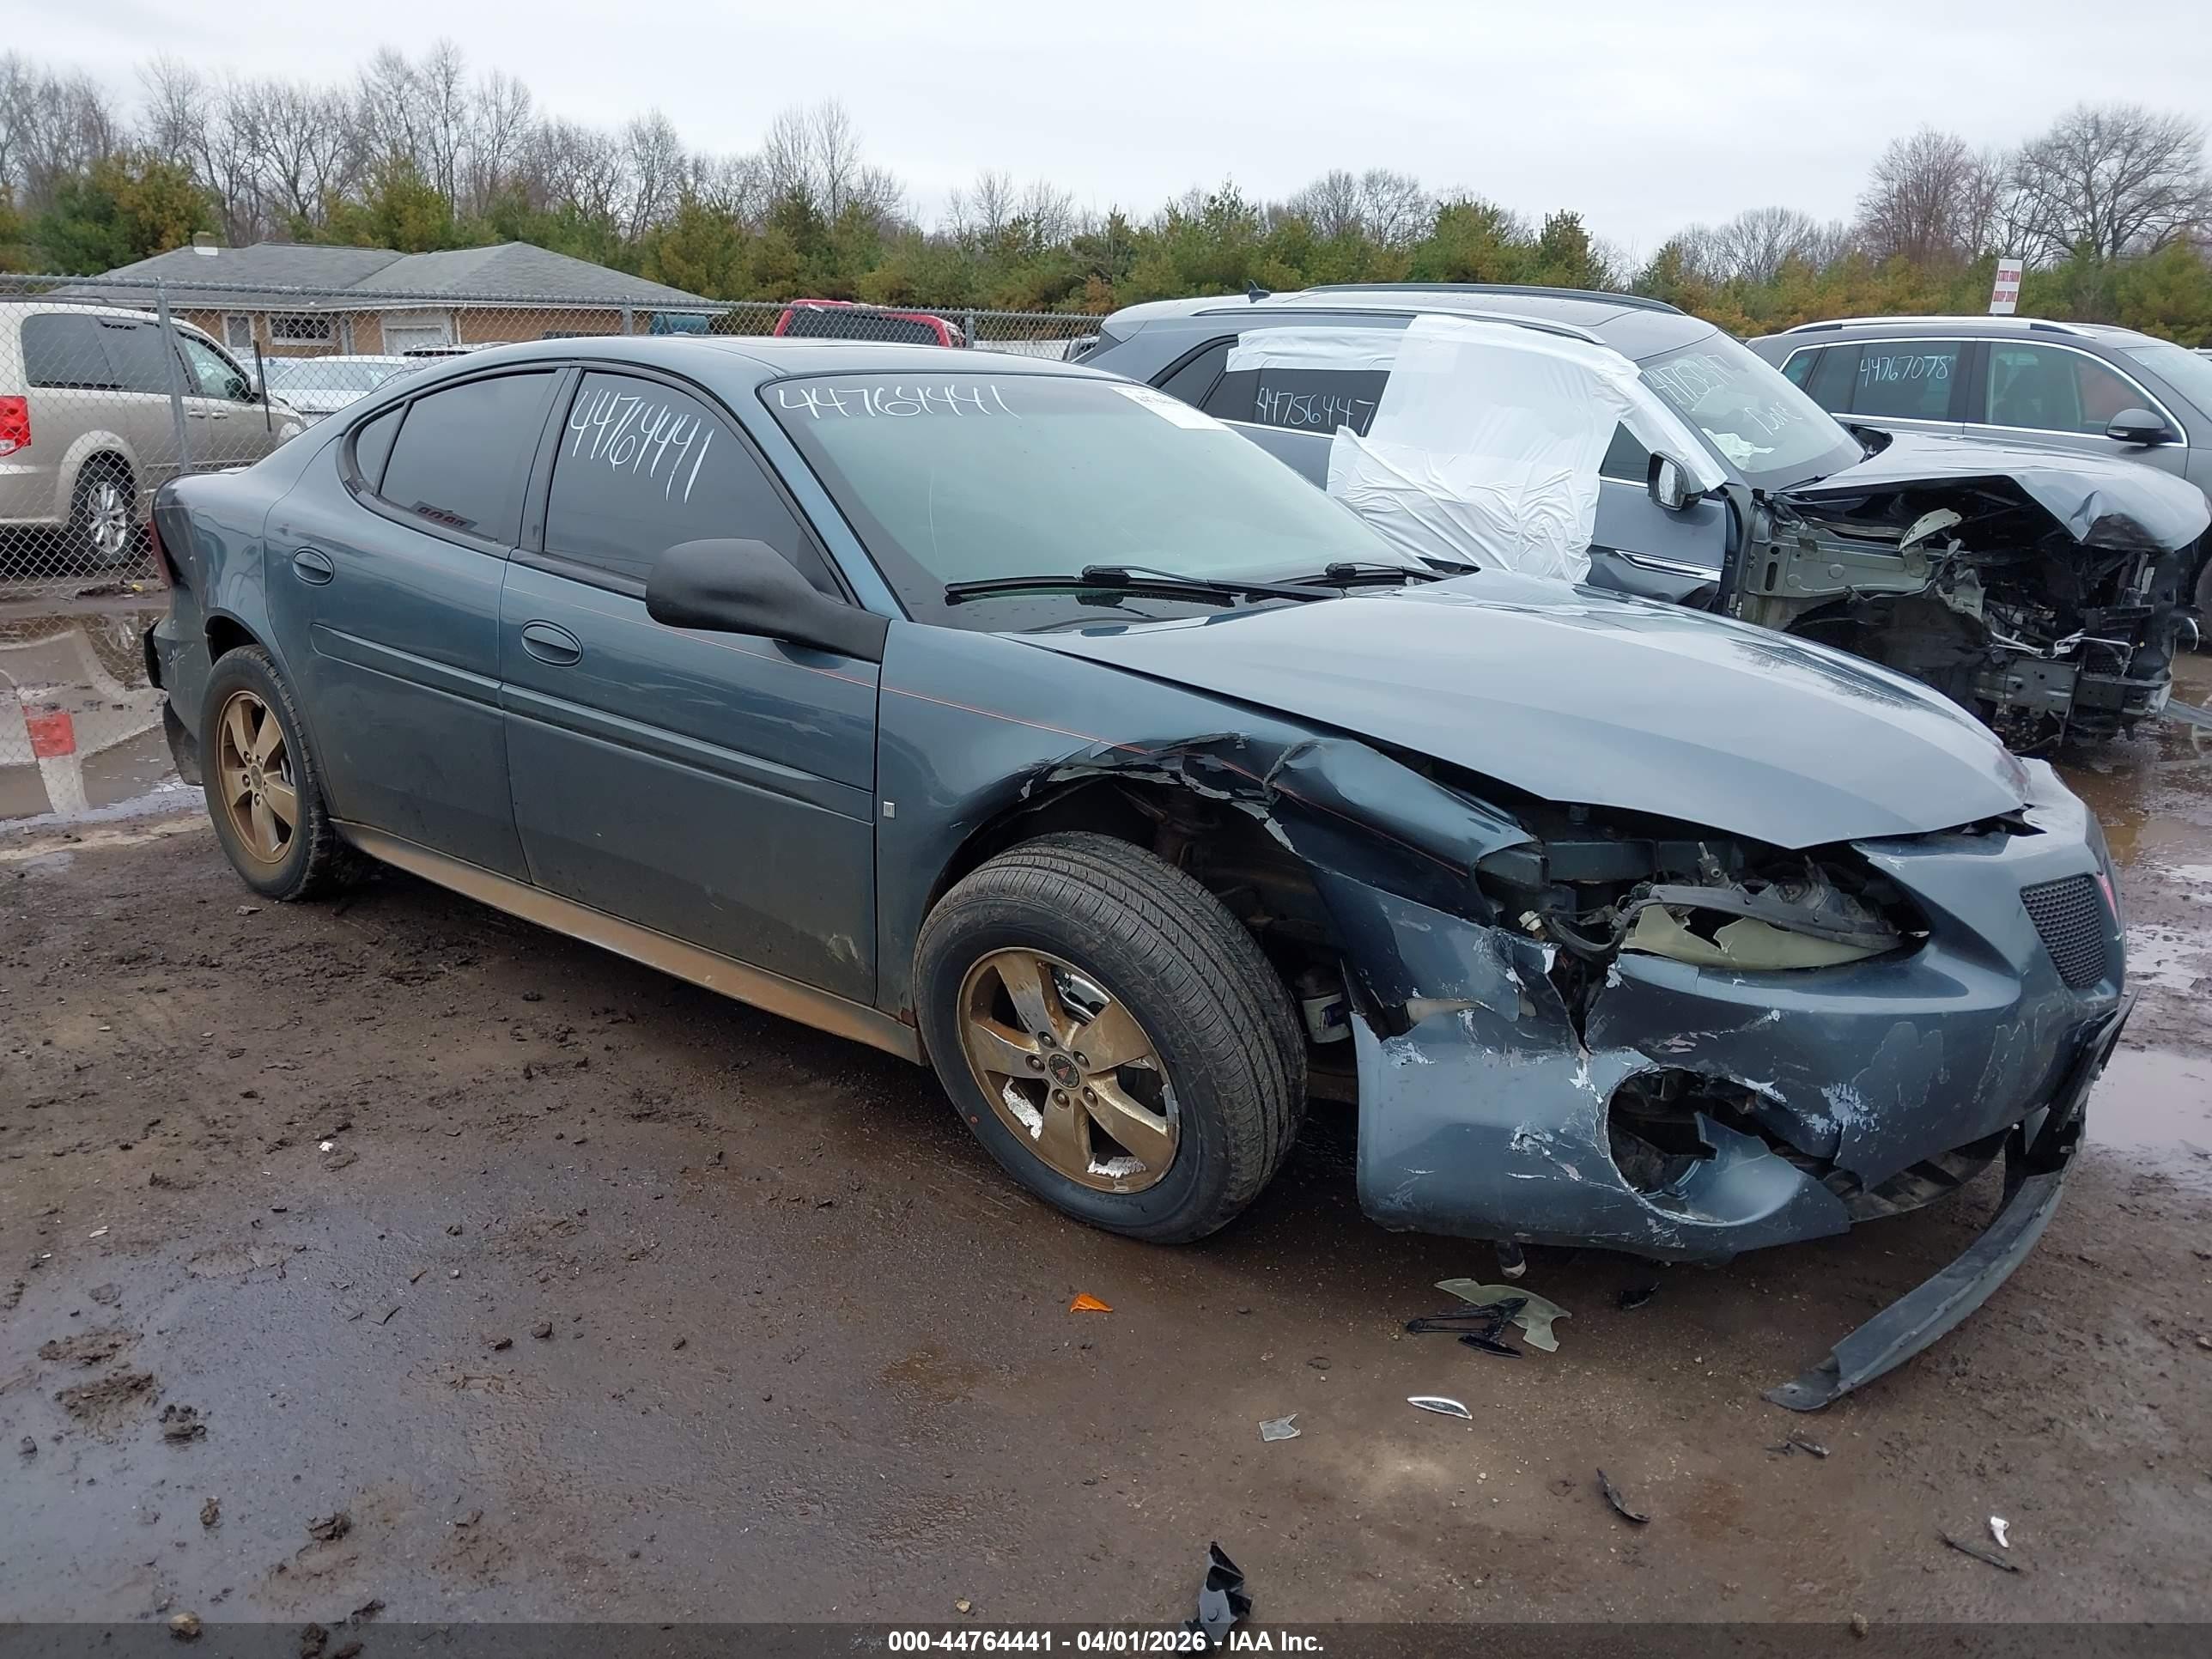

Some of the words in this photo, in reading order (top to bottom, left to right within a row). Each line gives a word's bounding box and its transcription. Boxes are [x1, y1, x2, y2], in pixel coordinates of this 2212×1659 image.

[1859, 355, 1954, 387] 44767078
[777, 385, 1023, 420] 44764441
[1255, 387, 1376, 436] 44756447
[570, 388, 715, 504] 44764441
